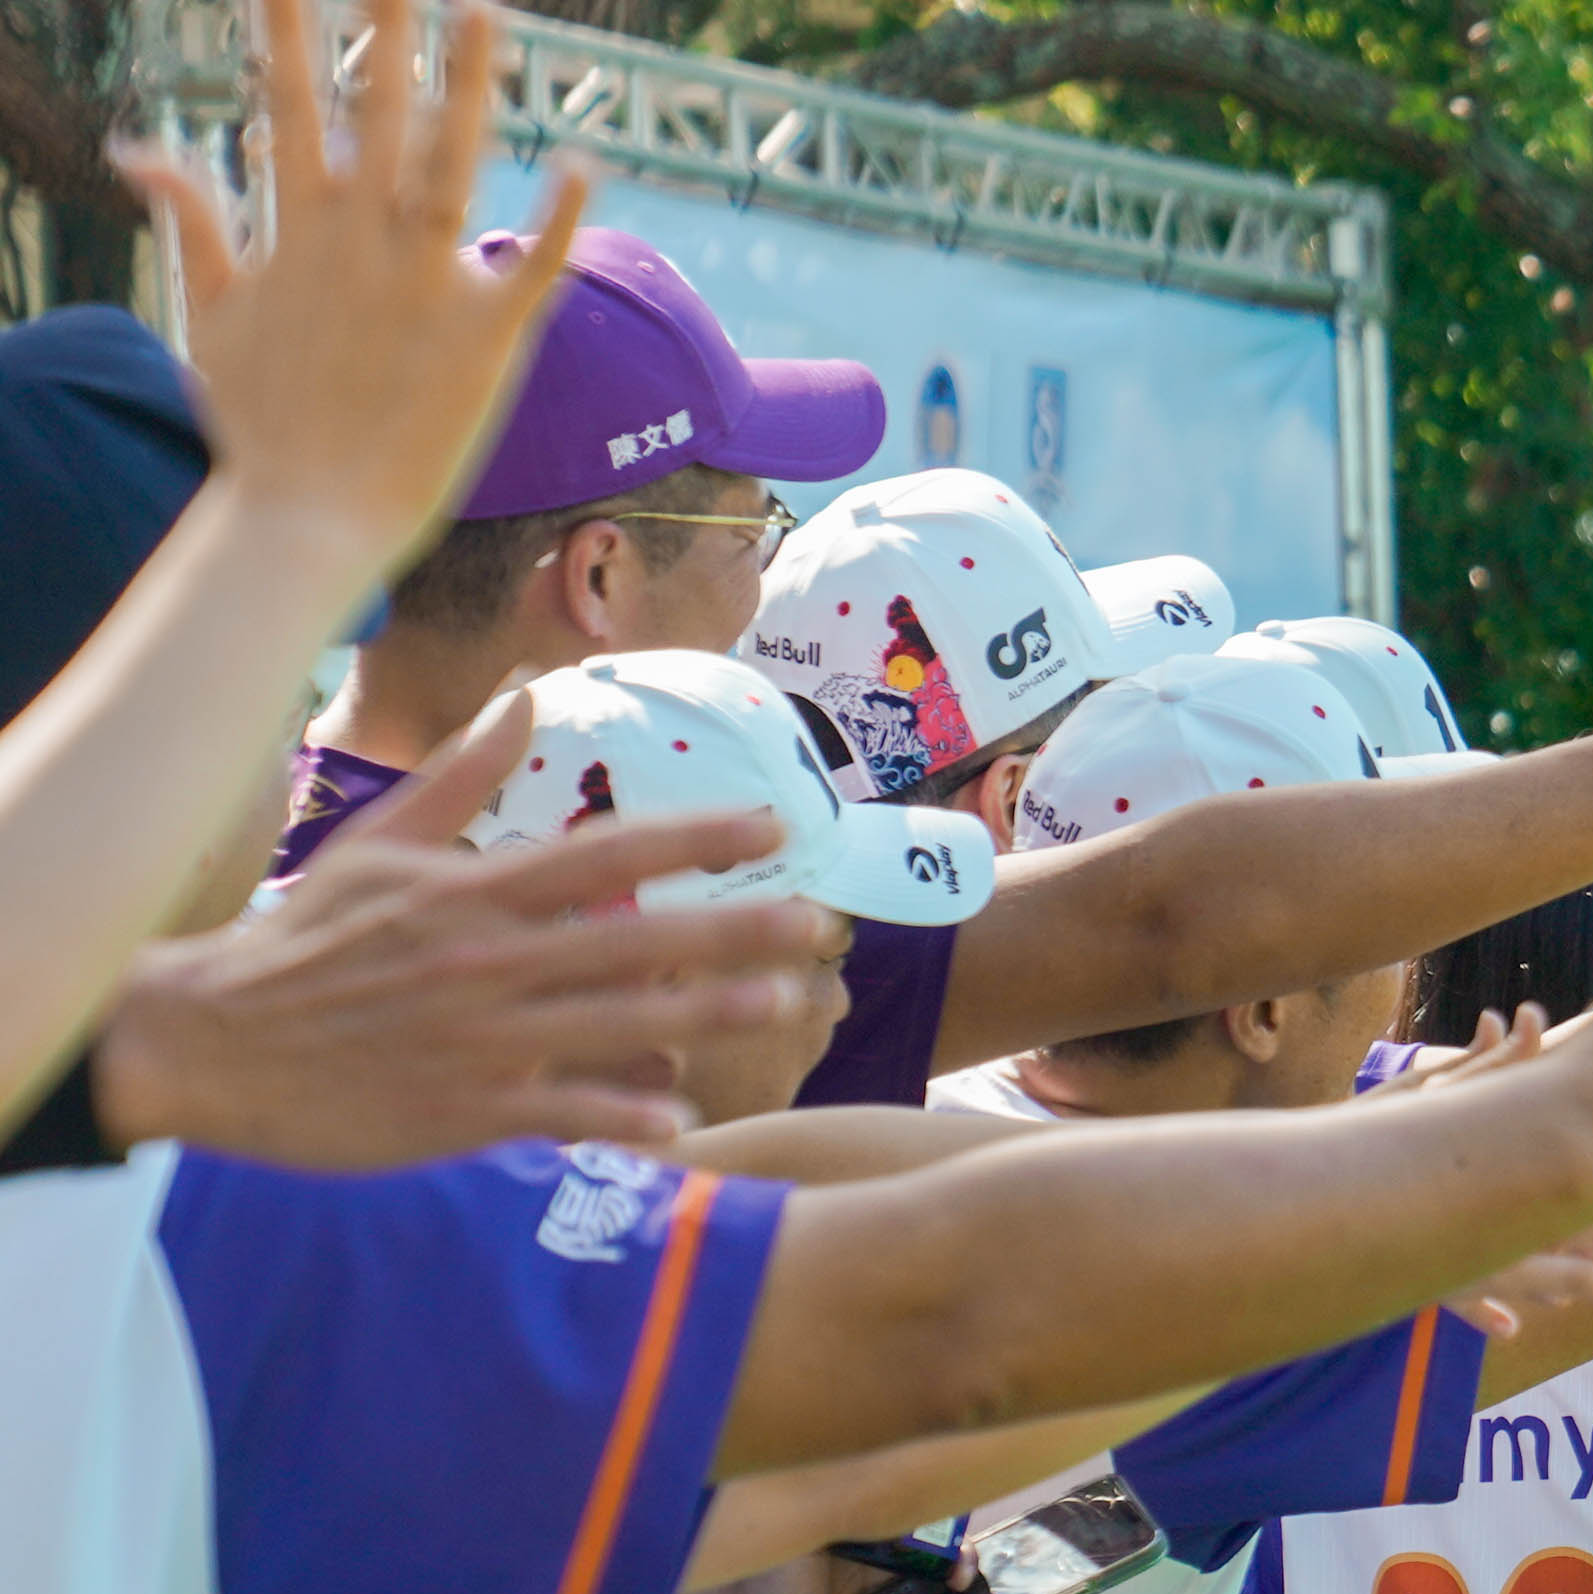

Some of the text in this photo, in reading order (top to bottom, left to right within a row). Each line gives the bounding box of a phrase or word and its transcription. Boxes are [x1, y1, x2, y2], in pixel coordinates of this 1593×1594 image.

[782, 637, 821, 668] Bull
[1008, 657, 1068, 701] ALPHATAURI
[1041, 806, 1082, 844] Bull
